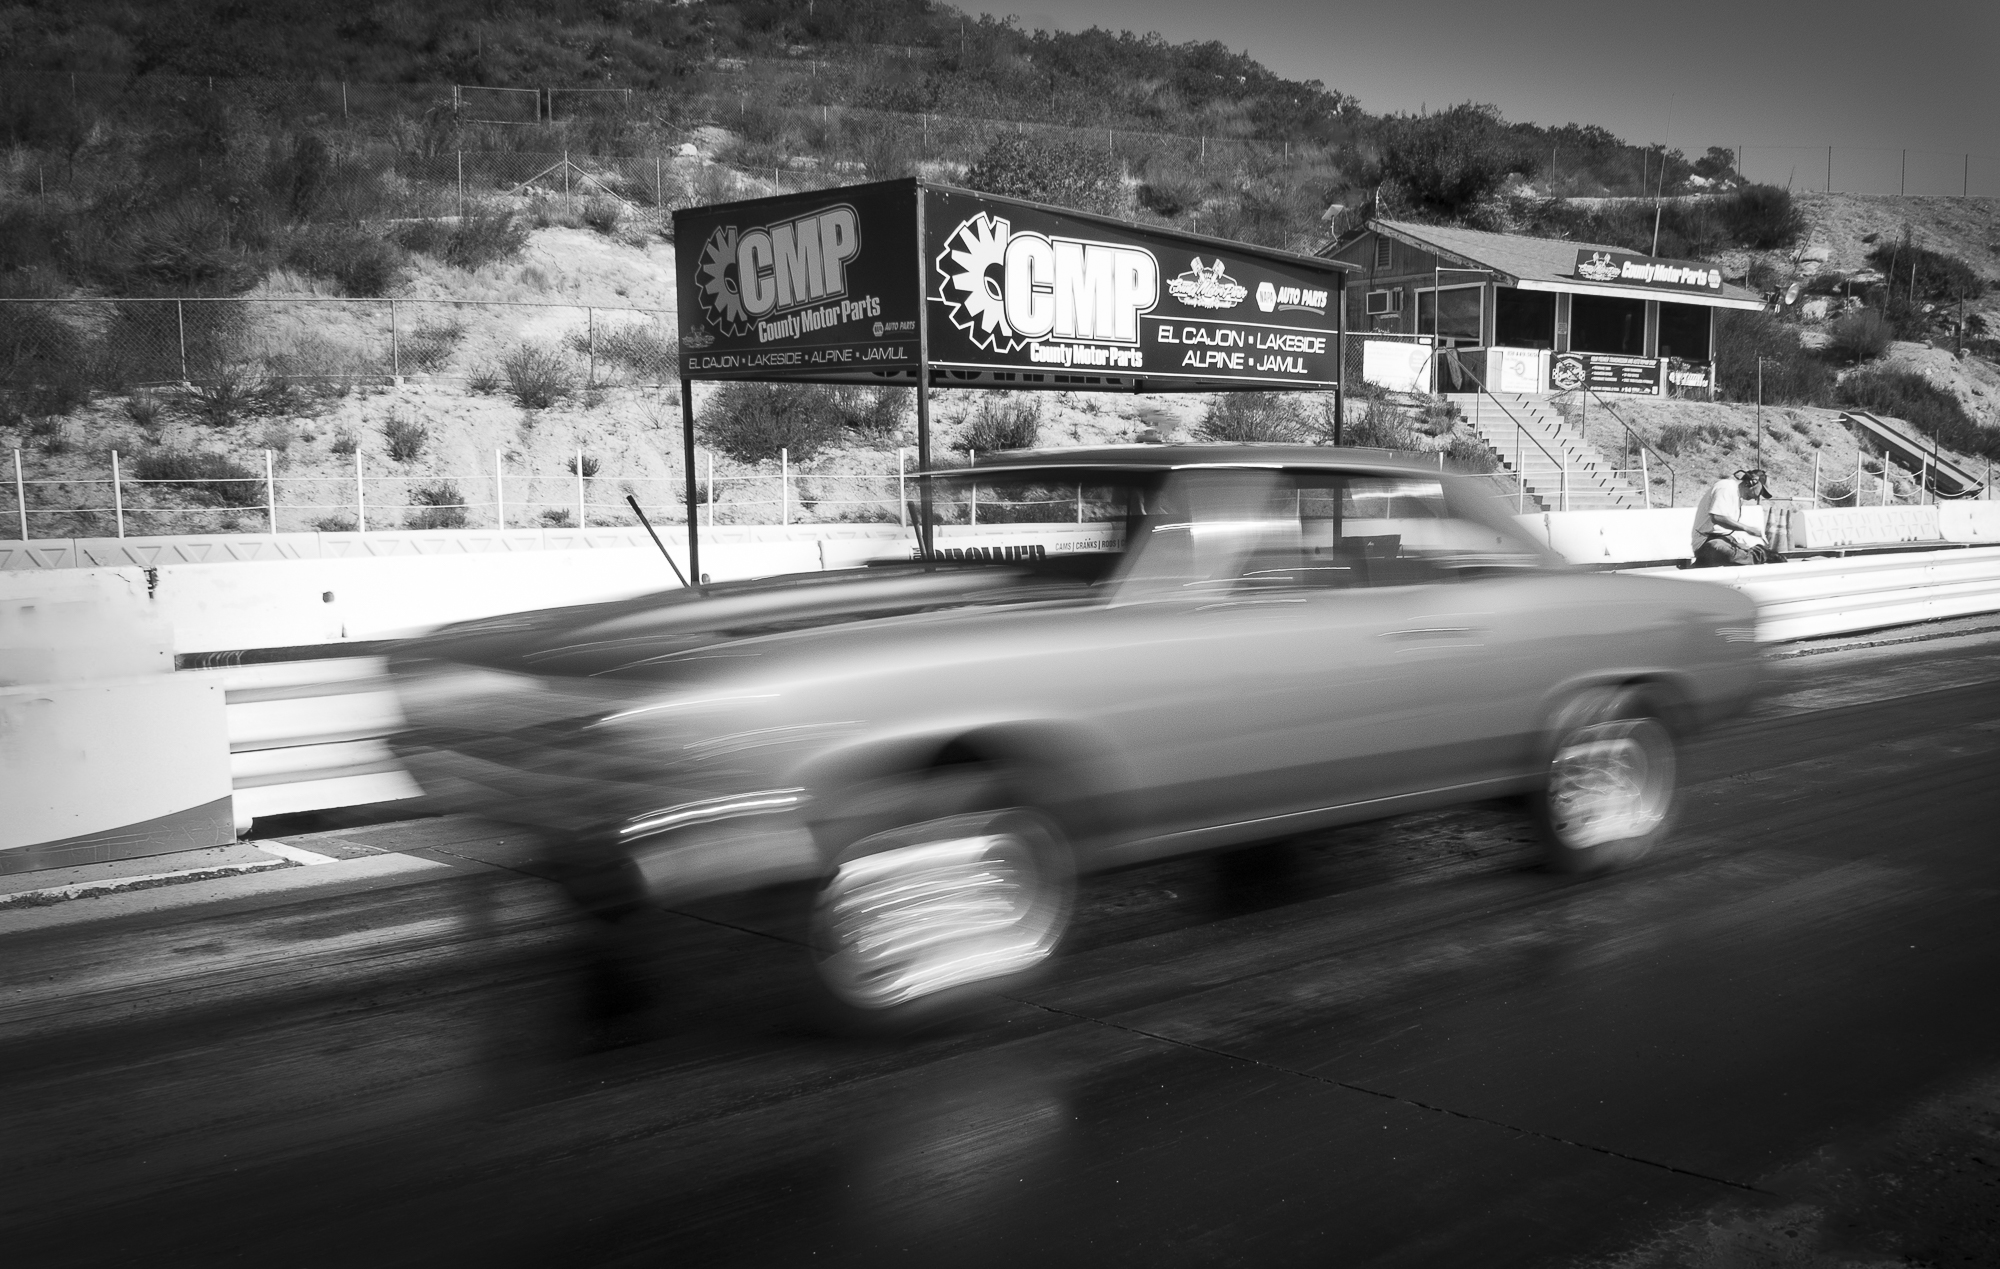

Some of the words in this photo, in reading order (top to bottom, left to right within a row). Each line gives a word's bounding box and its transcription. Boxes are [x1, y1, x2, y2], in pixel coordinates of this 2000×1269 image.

[737, 206, 859, 317] CMP
[1621, 261, 1654, 283] County
[1653, 264, 1682, 284] Motor
[1680, 267, 1708, 286] Parts
[1004, 233, 1158, 344] CMP
[1277, 286, 1301, 305] AUTO
[1301, 289, 1328, 308] PARTS
[758, 314, 800, 343] County
[801, 306, 841, 333] Motor
[841, 295, 881, 323] Parts
[885, 322, 899, 331] AUTO
[899, 320, 916, 331] PARTS
[1158, 325, 1179, 344] EL
[1182, 326, 1245, 348] CAJON
[1256, 334, 1326, 354] LAKESIDE
[688, 358, 701, 369] EL
[702, 356, 739, 368] CAJON
[748, 352, 802, 366] LAKESIDE
[811, 349, 853, 363] ALPINE
[862, 347, 908, 360] JAMUL
[1030, 342, 1072, 367] County
[1073, 344, 1110, 366] Motor
[1109, 346, 1143, 368] Parts
[1182, 350, 1245, 370] ALPINE
[1257, 355, 1308, 374] JAMUL
[1055, 541, 1072, 551] CAMS
[1075, 540, 1098, 550] CRANKS
[1101, 539, 1117, 548] RODS
